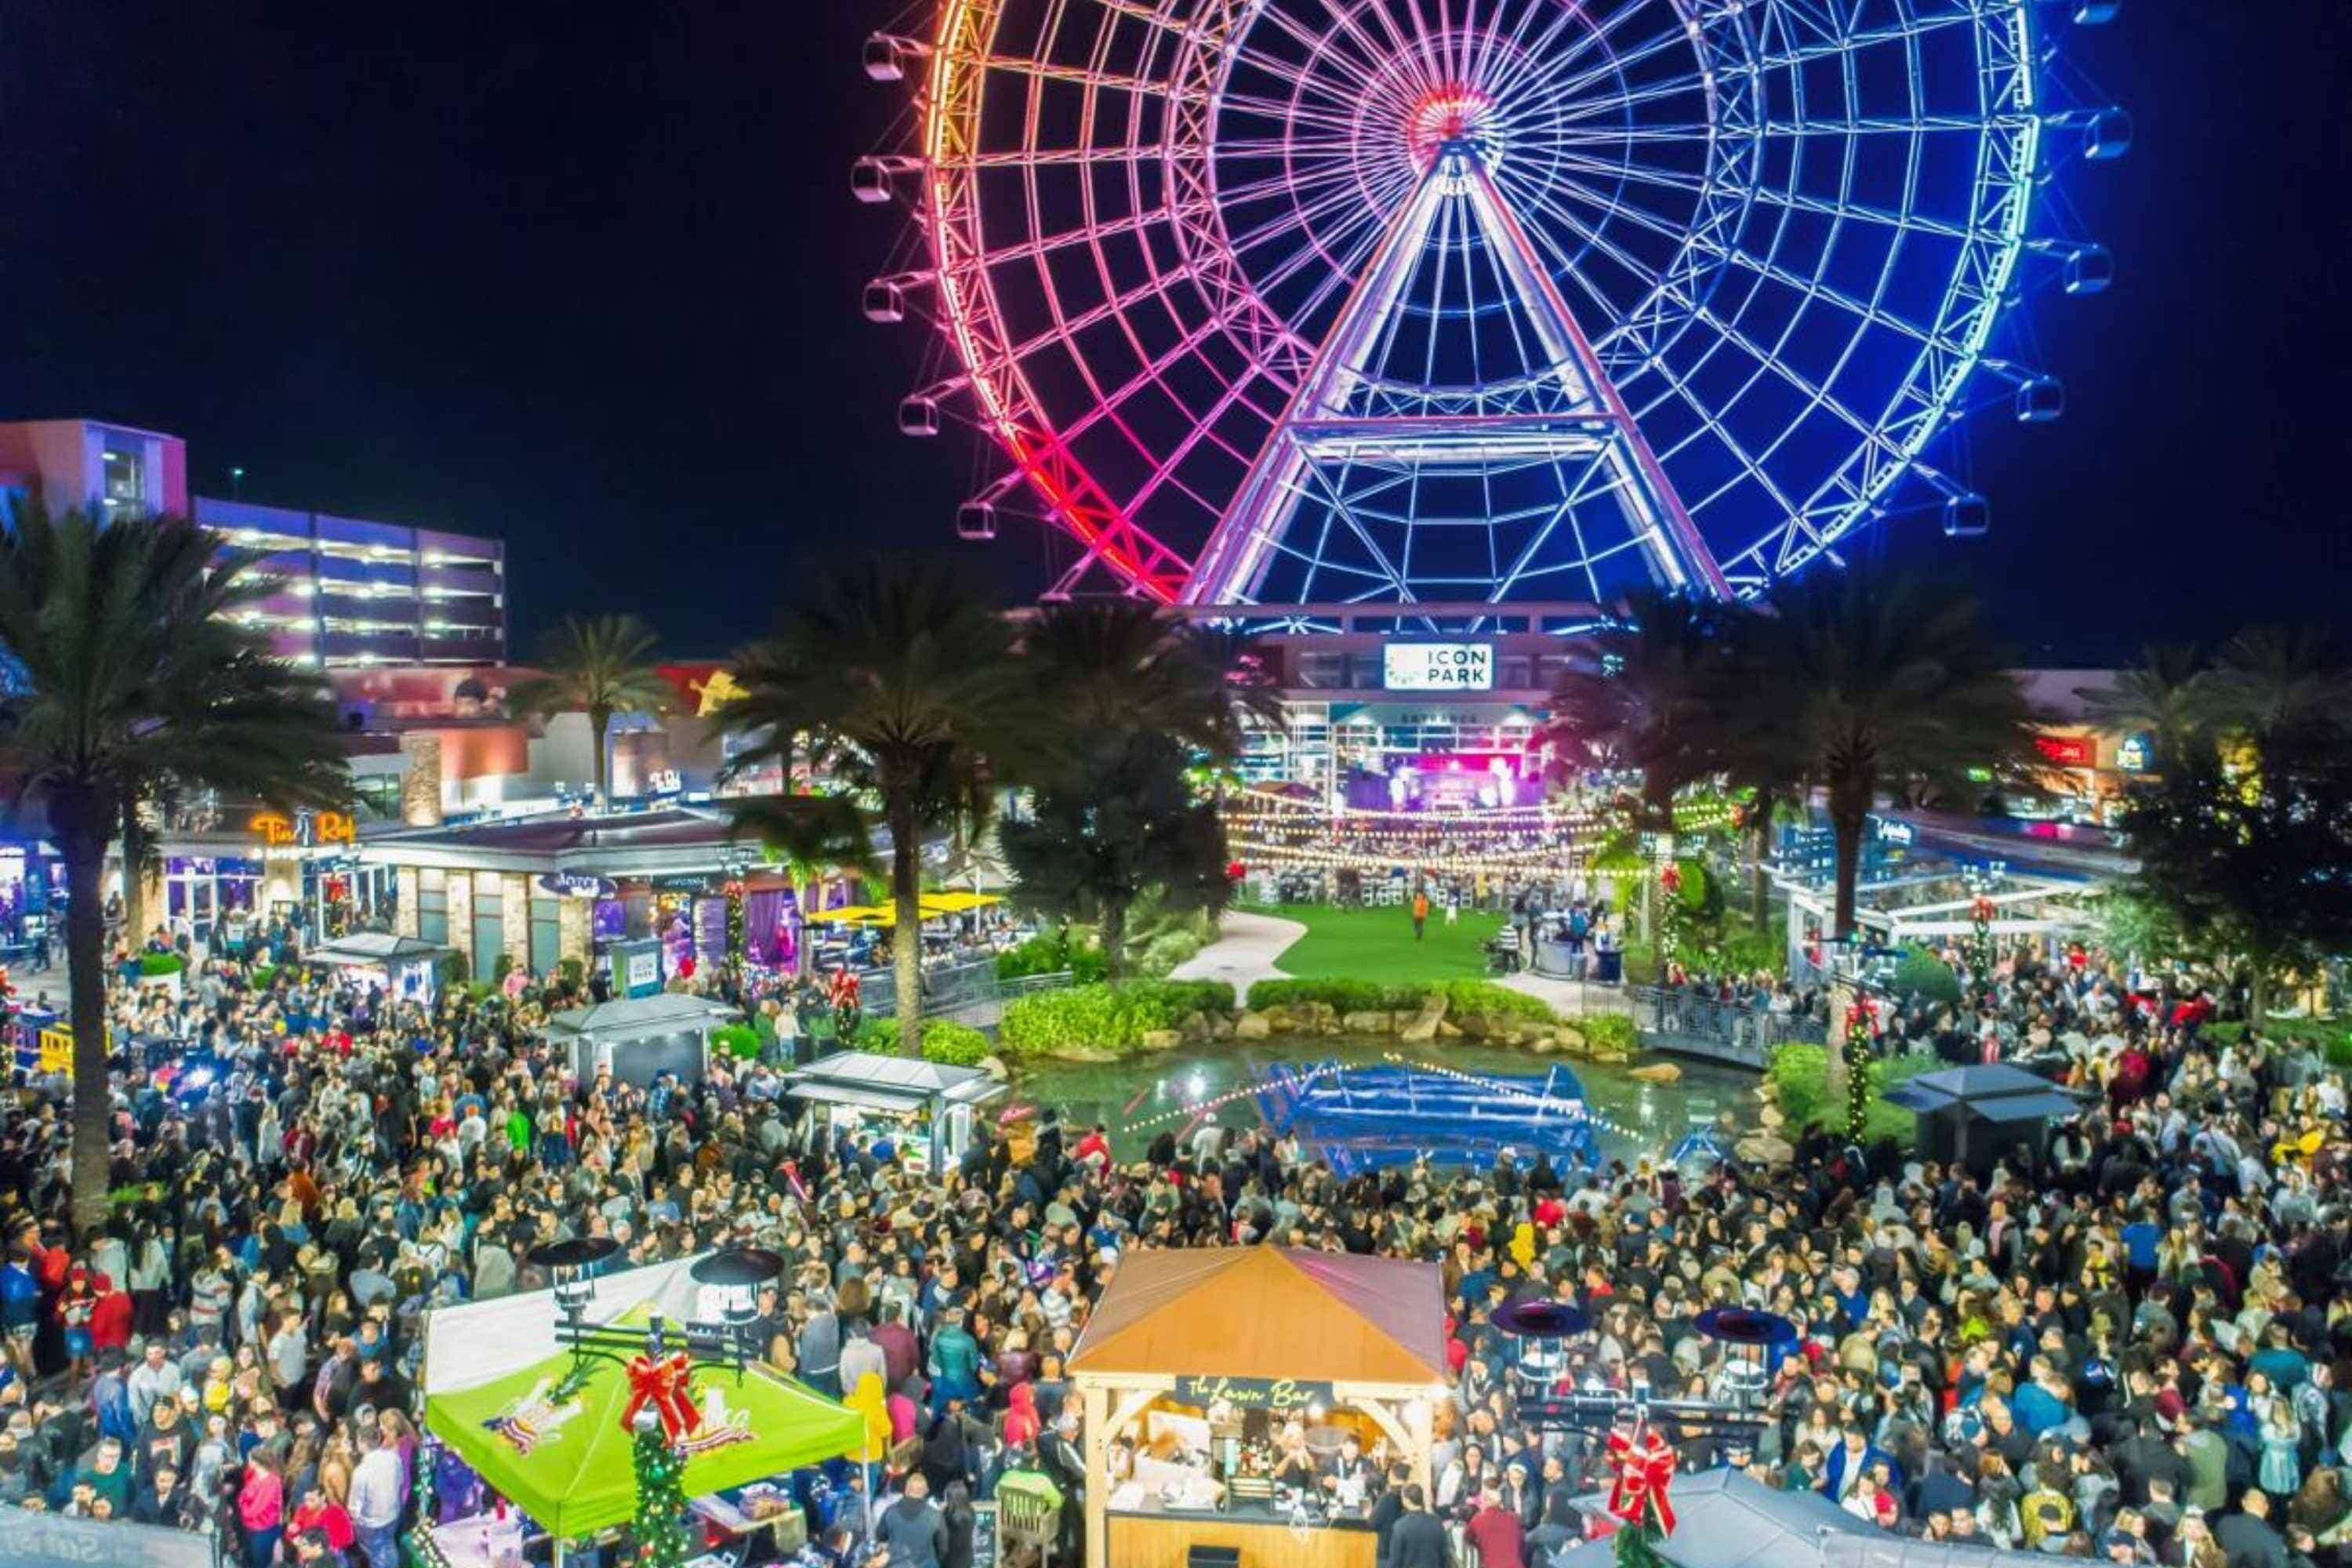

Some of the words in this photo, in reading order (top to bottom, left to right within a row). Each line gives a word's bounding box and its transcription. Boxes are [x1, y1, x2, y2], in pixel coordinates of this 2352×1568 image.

[1428, 650, 1486, 665] ICON
[1428, 668, 1486, 683] PARK
[1187, 1375, 1210, 1398] The
[1209, 1377, 1265, 1403] Lawn
[1270, 1379, 1315, 1406] Bar
